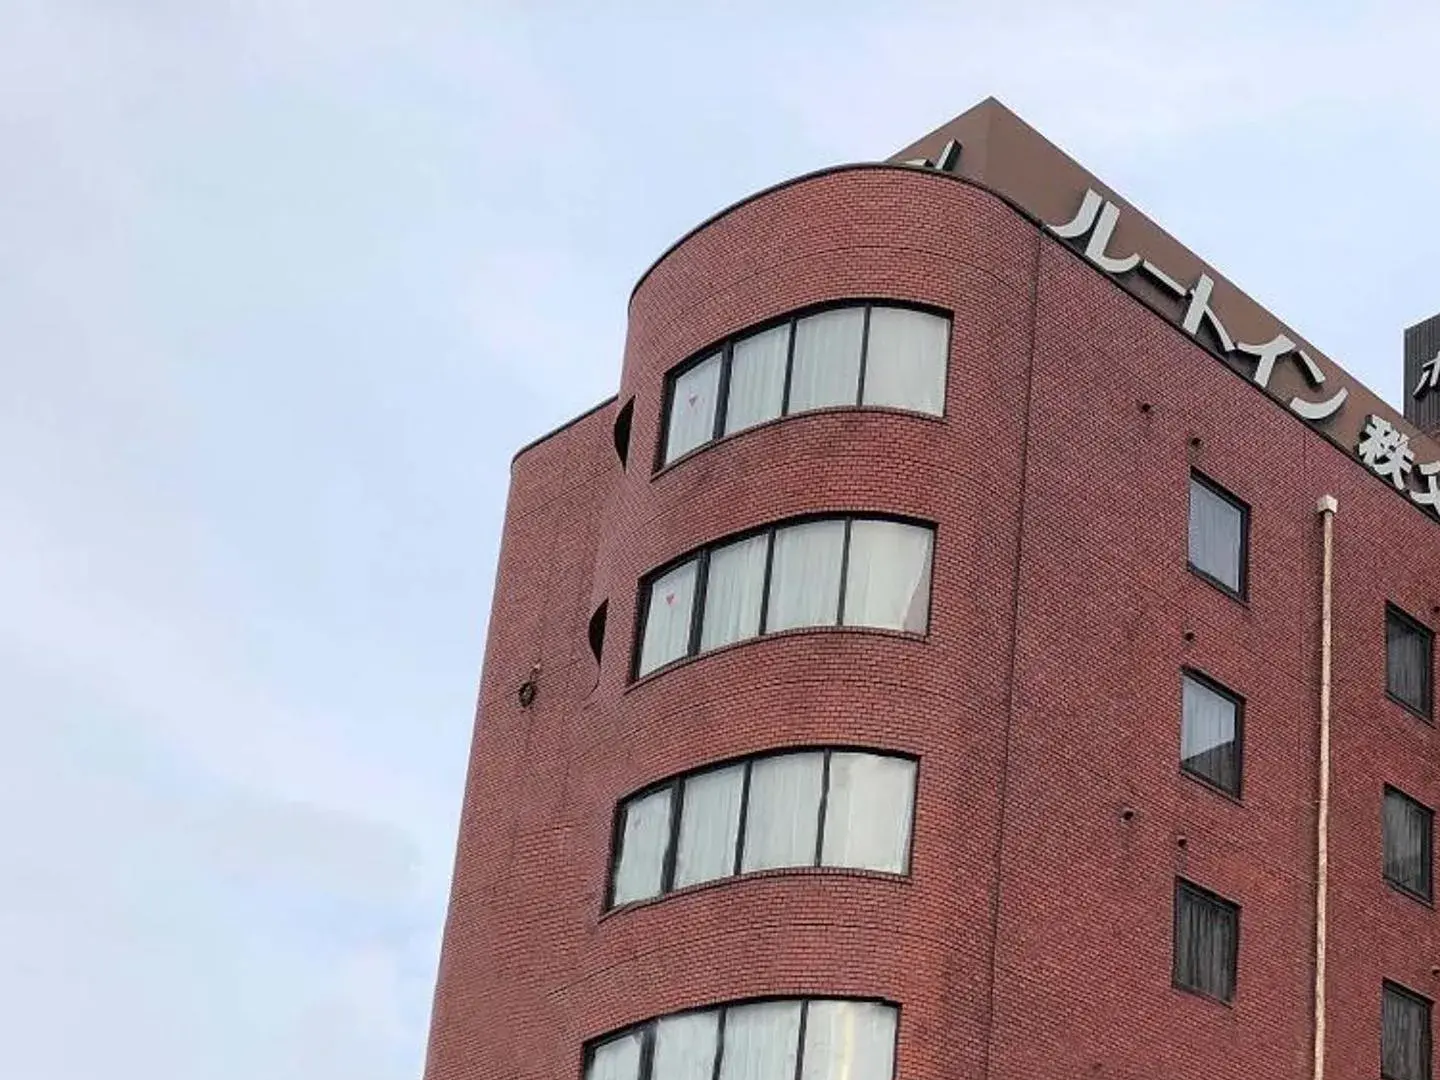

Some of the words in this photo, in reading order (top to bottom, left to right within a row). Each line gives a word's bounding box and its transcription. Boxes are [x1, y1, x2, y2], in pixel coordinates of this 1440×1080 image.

[1046, 188, 1348, 421] ルートイン
